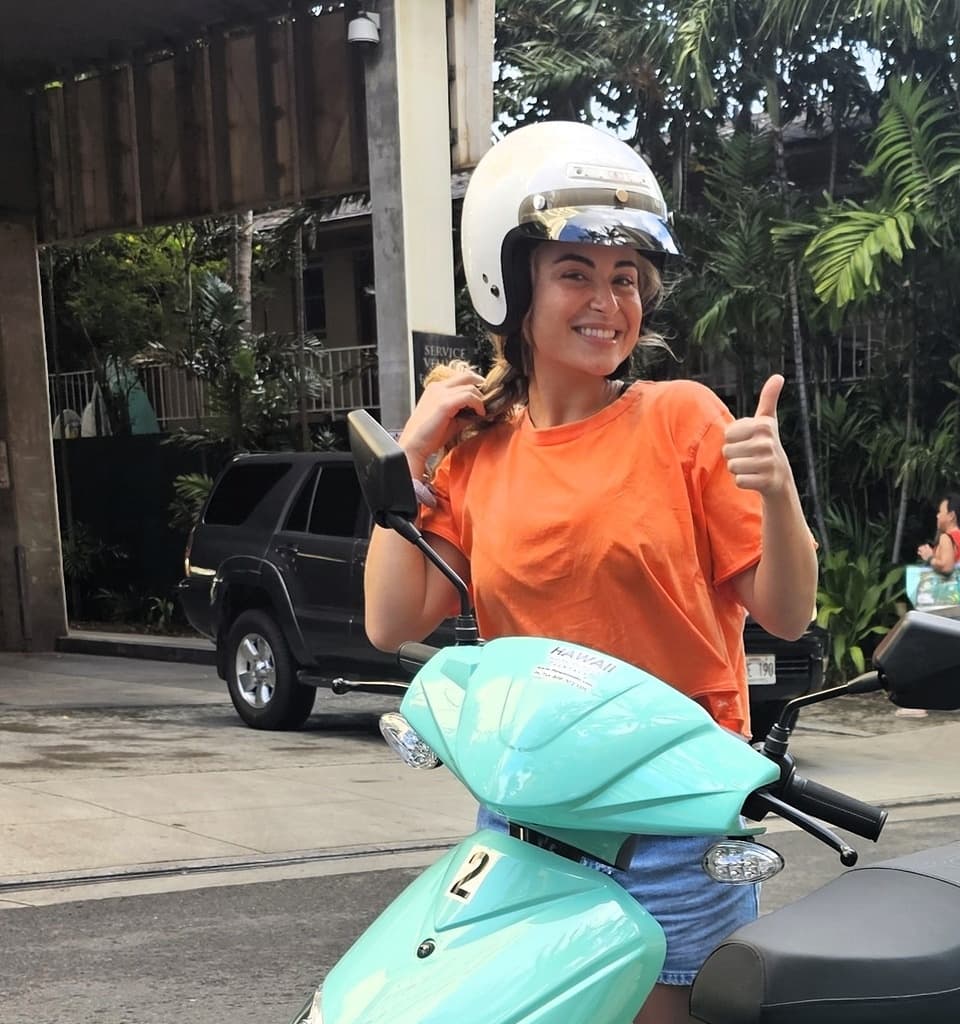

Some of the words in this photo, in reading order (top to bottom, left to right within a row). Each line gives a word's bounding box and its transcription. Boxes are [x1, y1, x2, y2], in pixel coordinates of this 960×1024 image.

[424, 344, 466, 359] SERVICE
[550, 646, 617, 673] HAWAII
[449, 851, 490, 900] 2
